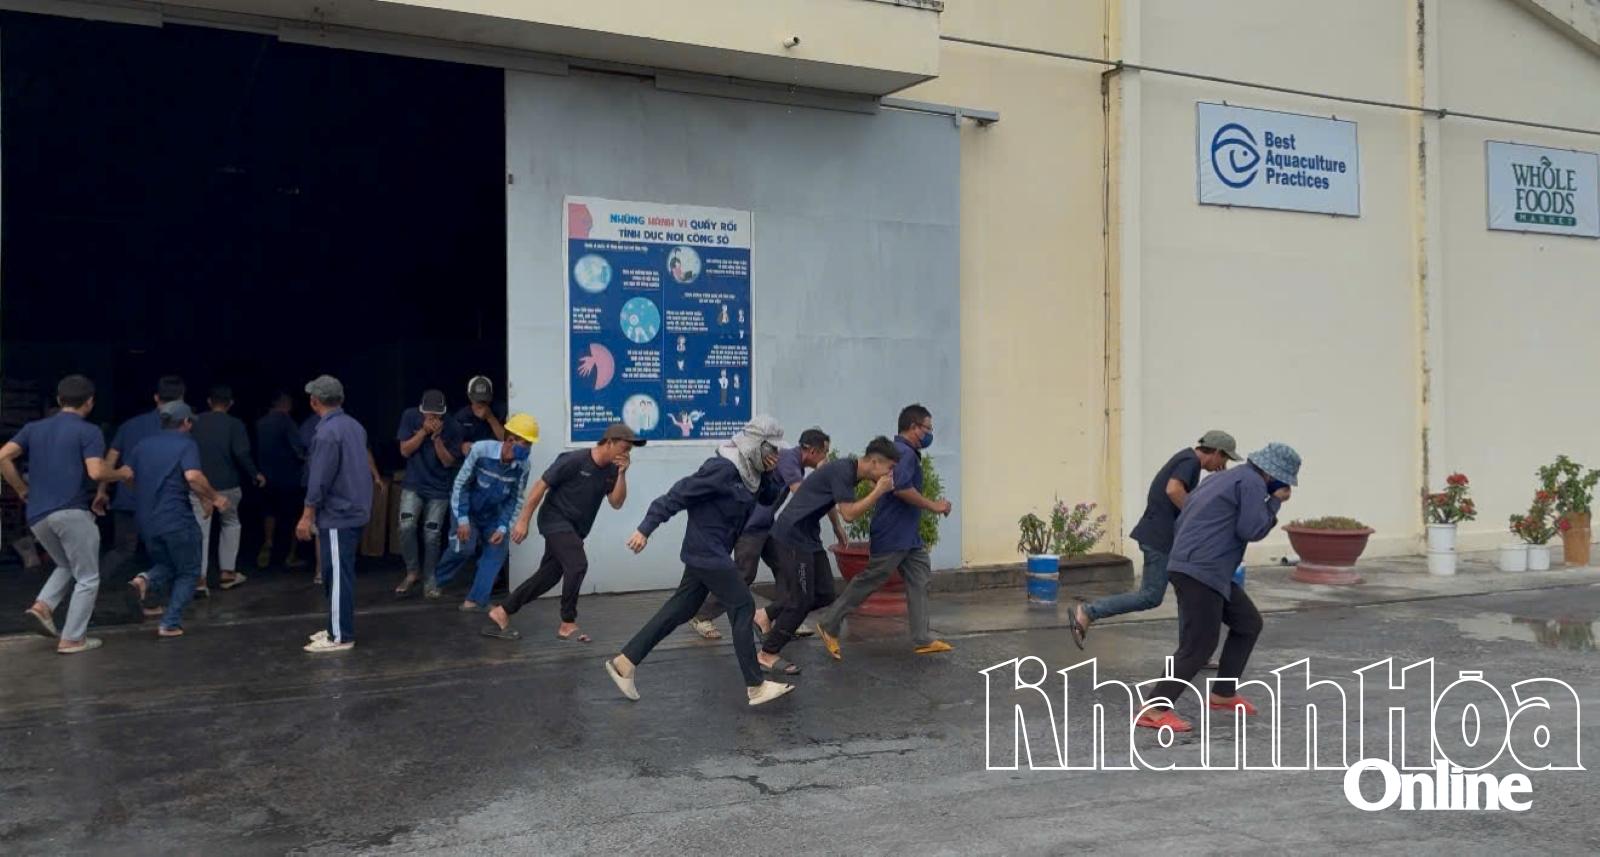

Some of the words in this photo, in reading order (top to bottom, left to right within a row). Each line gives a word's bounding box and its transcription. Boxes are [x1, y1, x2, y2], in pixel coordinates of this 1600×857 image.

[1264, 131, 1296, 150] Best
[1265, 149, 1347, 174] Aquaculture
[1266, 167, 1330, 190] Practices
[1511, 163, 1577, 191] WHOLE
[1513, 188, 1575, 215] FOODS
